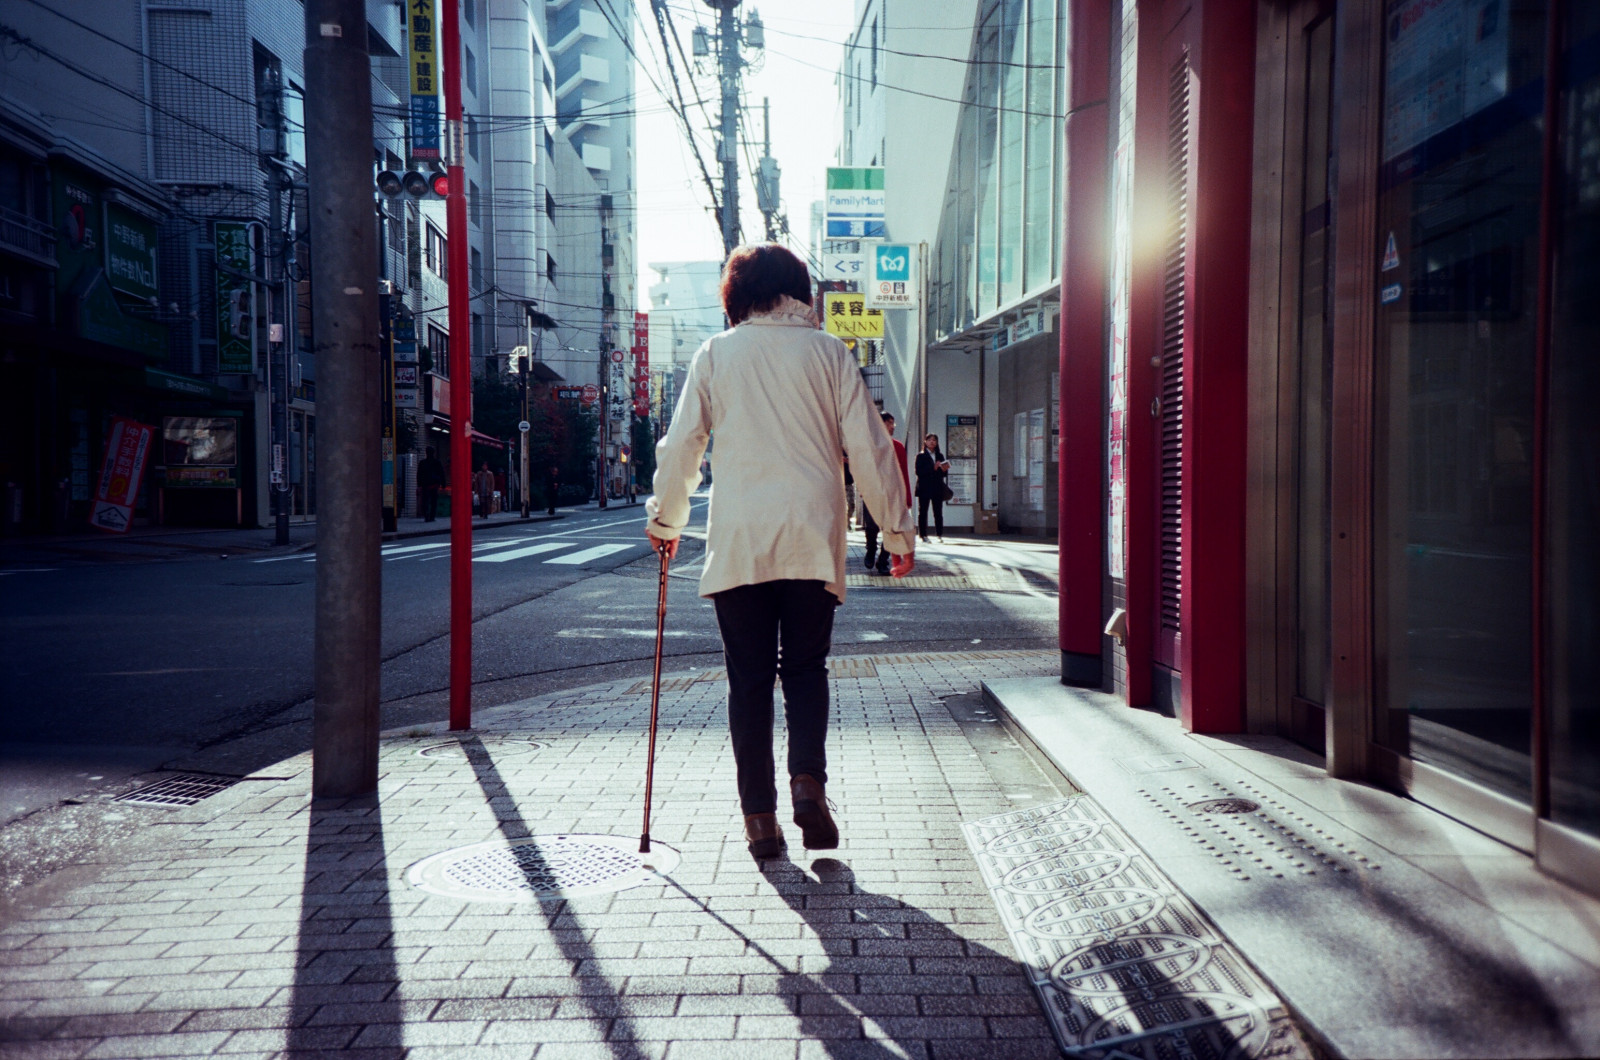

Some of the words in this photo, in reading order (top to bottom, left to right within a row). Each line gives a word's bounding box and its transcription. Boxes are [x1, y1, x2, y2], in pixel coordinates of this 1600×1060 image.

[428, 100, 437, 145] カクスイ
[829, 195, 884, 207] FamilyMart
[639, 337, 648, 391] EIKO
